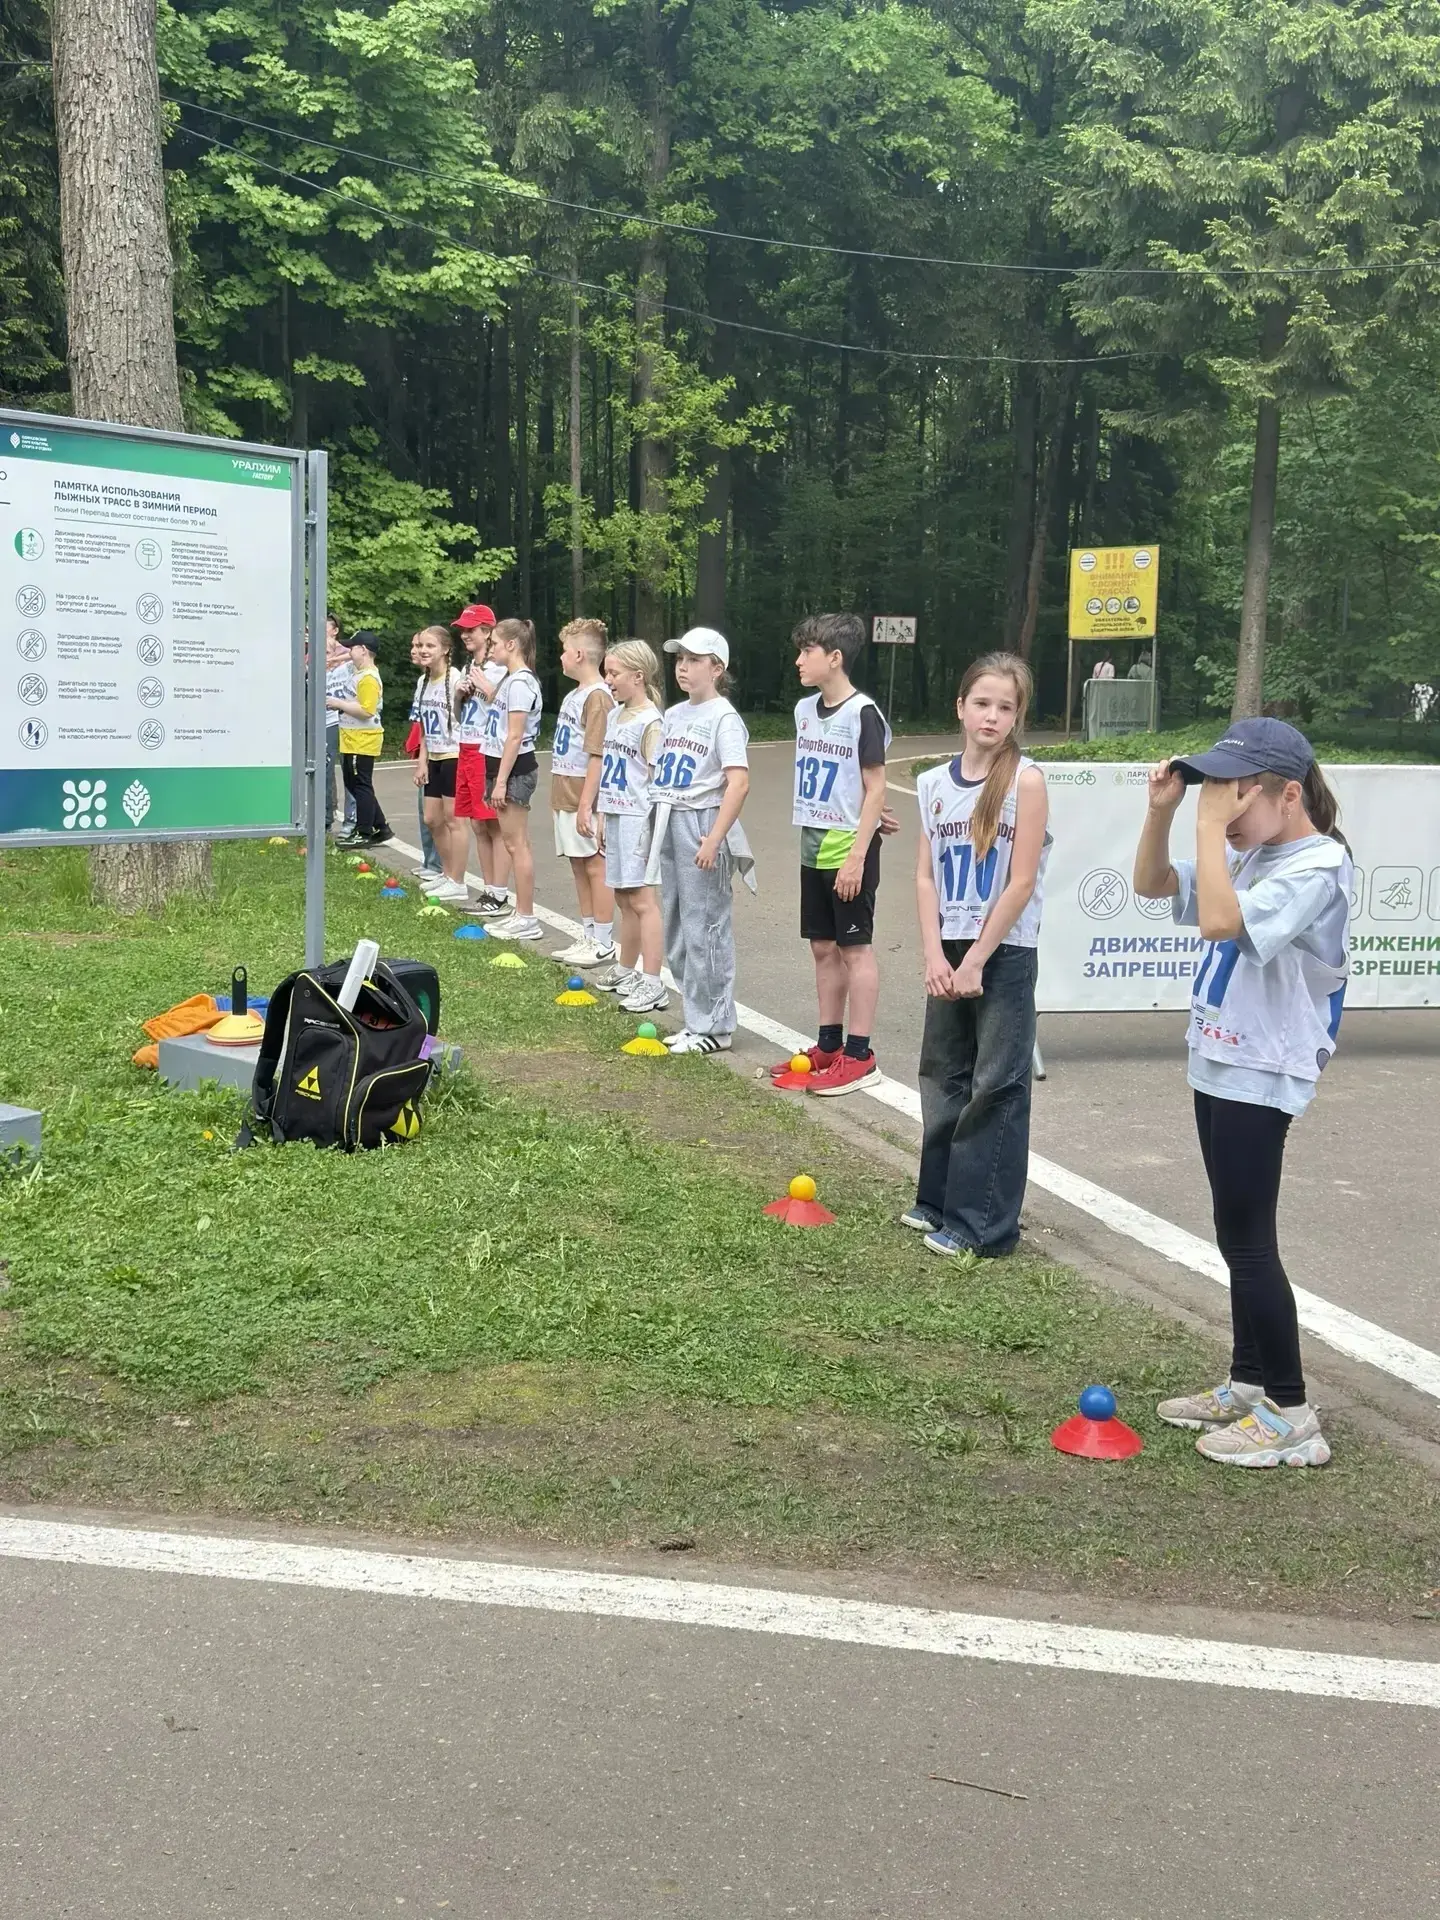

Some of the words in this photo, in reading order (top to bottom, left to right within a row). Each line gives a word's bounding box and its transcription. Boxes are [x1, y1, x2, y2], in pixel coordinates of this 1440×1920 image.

[232, 460, 281, 474] УРАЛХИМ
[54, 480, 99, 493] ПАМЯТКА
[101, 484, 181, 502] ИСПОЛЬЗОВАНИЯ
[54, 491, 101, 505] ЛЫЖНЫХ
[103, 496, 131, 509] ТРАСС
[134, 500, 140, 508] В
[142, 500, 181, 513] ЗИМНИЙ
[183, 506, 218, 518] ПЕРИОД
[54, 505, 78, 514] Помни!
[80, 508, 110, 518] Перепад
[111, 512, 132, 520] высот
[133, 514, 169, 523] составляет
[170, 517, 189, 526] более
[190, 518, 199, 526] 70
[55, 530, 86, 538] Движение
[85, 540, 130, 548] осуществляется
[55, 544, 77, 552] против
[57, 633, 90, 641] Запрещено
[422, 710, 441, 735] 12
[797, 735, 854, 760] СпортВектор
[601, 754, 629, 792] 24
[796, 755, 840, 803] 137
[1350, 960, 1440, 976] ЗРЕШЕН
